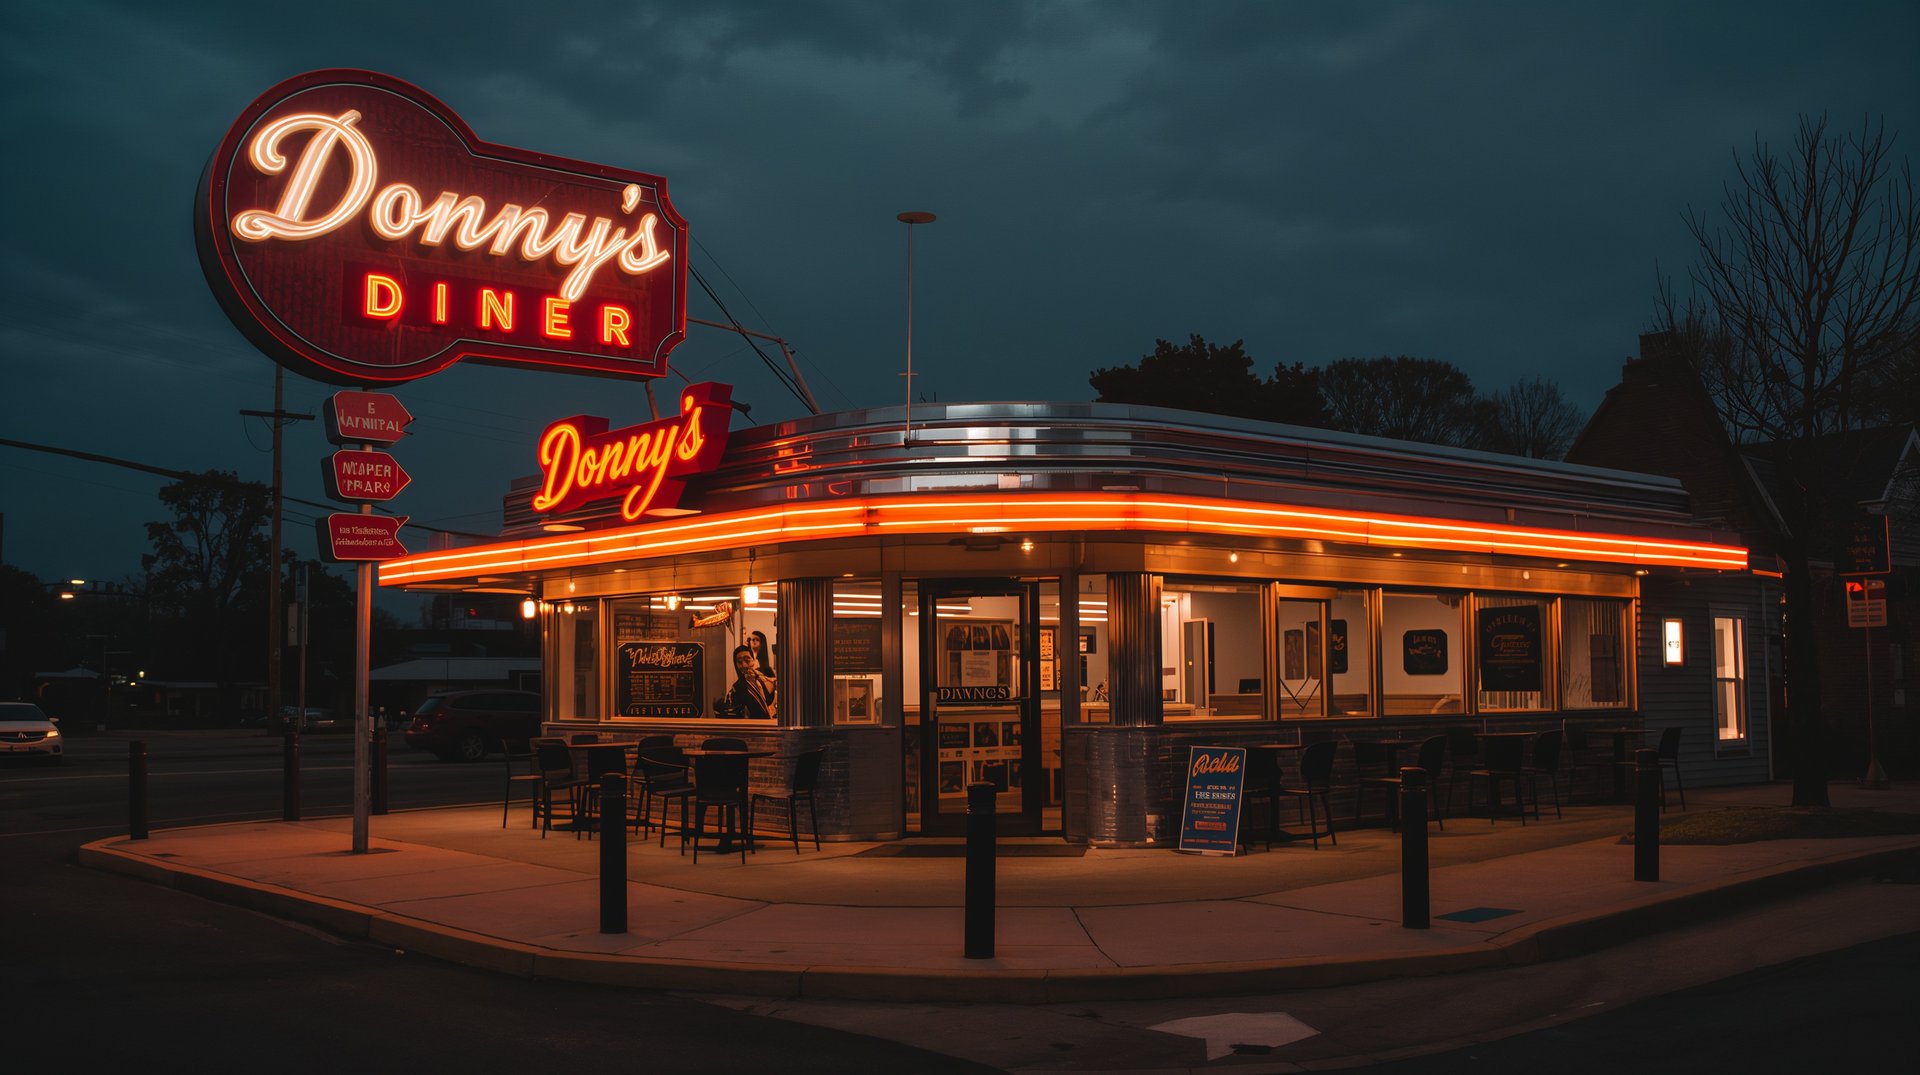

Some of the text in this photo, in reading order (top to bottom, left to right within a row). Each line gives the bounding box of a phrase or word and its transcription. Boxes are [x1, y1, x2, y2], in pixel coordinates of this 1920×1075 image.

[230, 109, 671, 302] Donny's
[363, 273, 632, 347] DINER
[532, 395, 704, 521] Donny's
